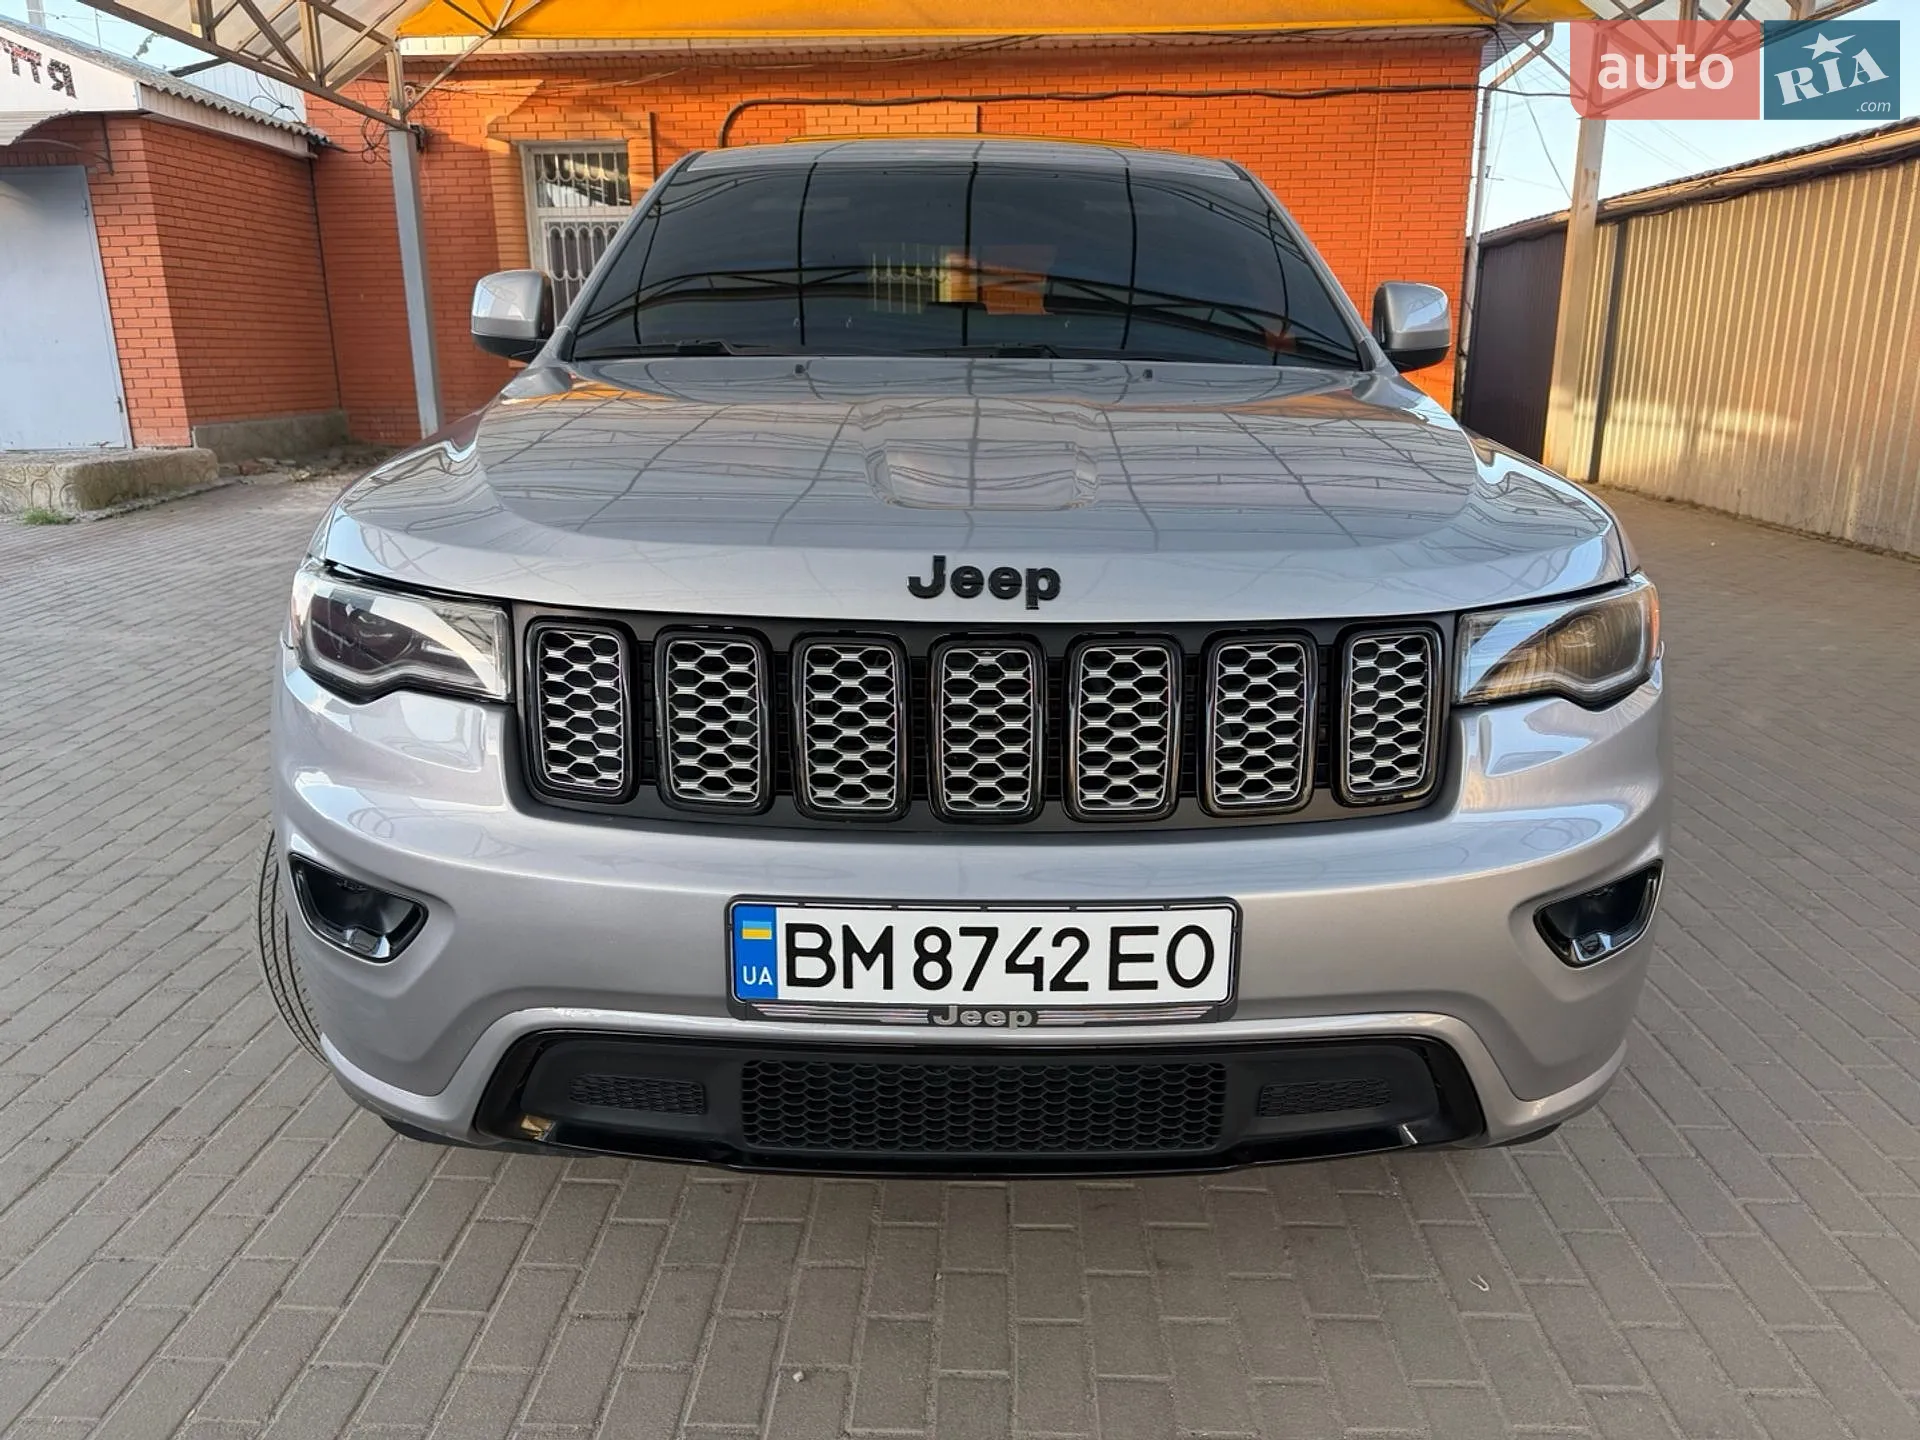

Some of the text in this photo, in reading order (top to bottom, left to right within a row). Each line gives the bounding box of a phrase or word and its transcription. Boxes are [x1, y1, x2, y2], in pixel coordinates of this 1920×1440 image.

[907, 555, 1061, 610] Jeep
[742, 965, 773, 986] UA
[932, 1005, 1034, 1029] Jeep
